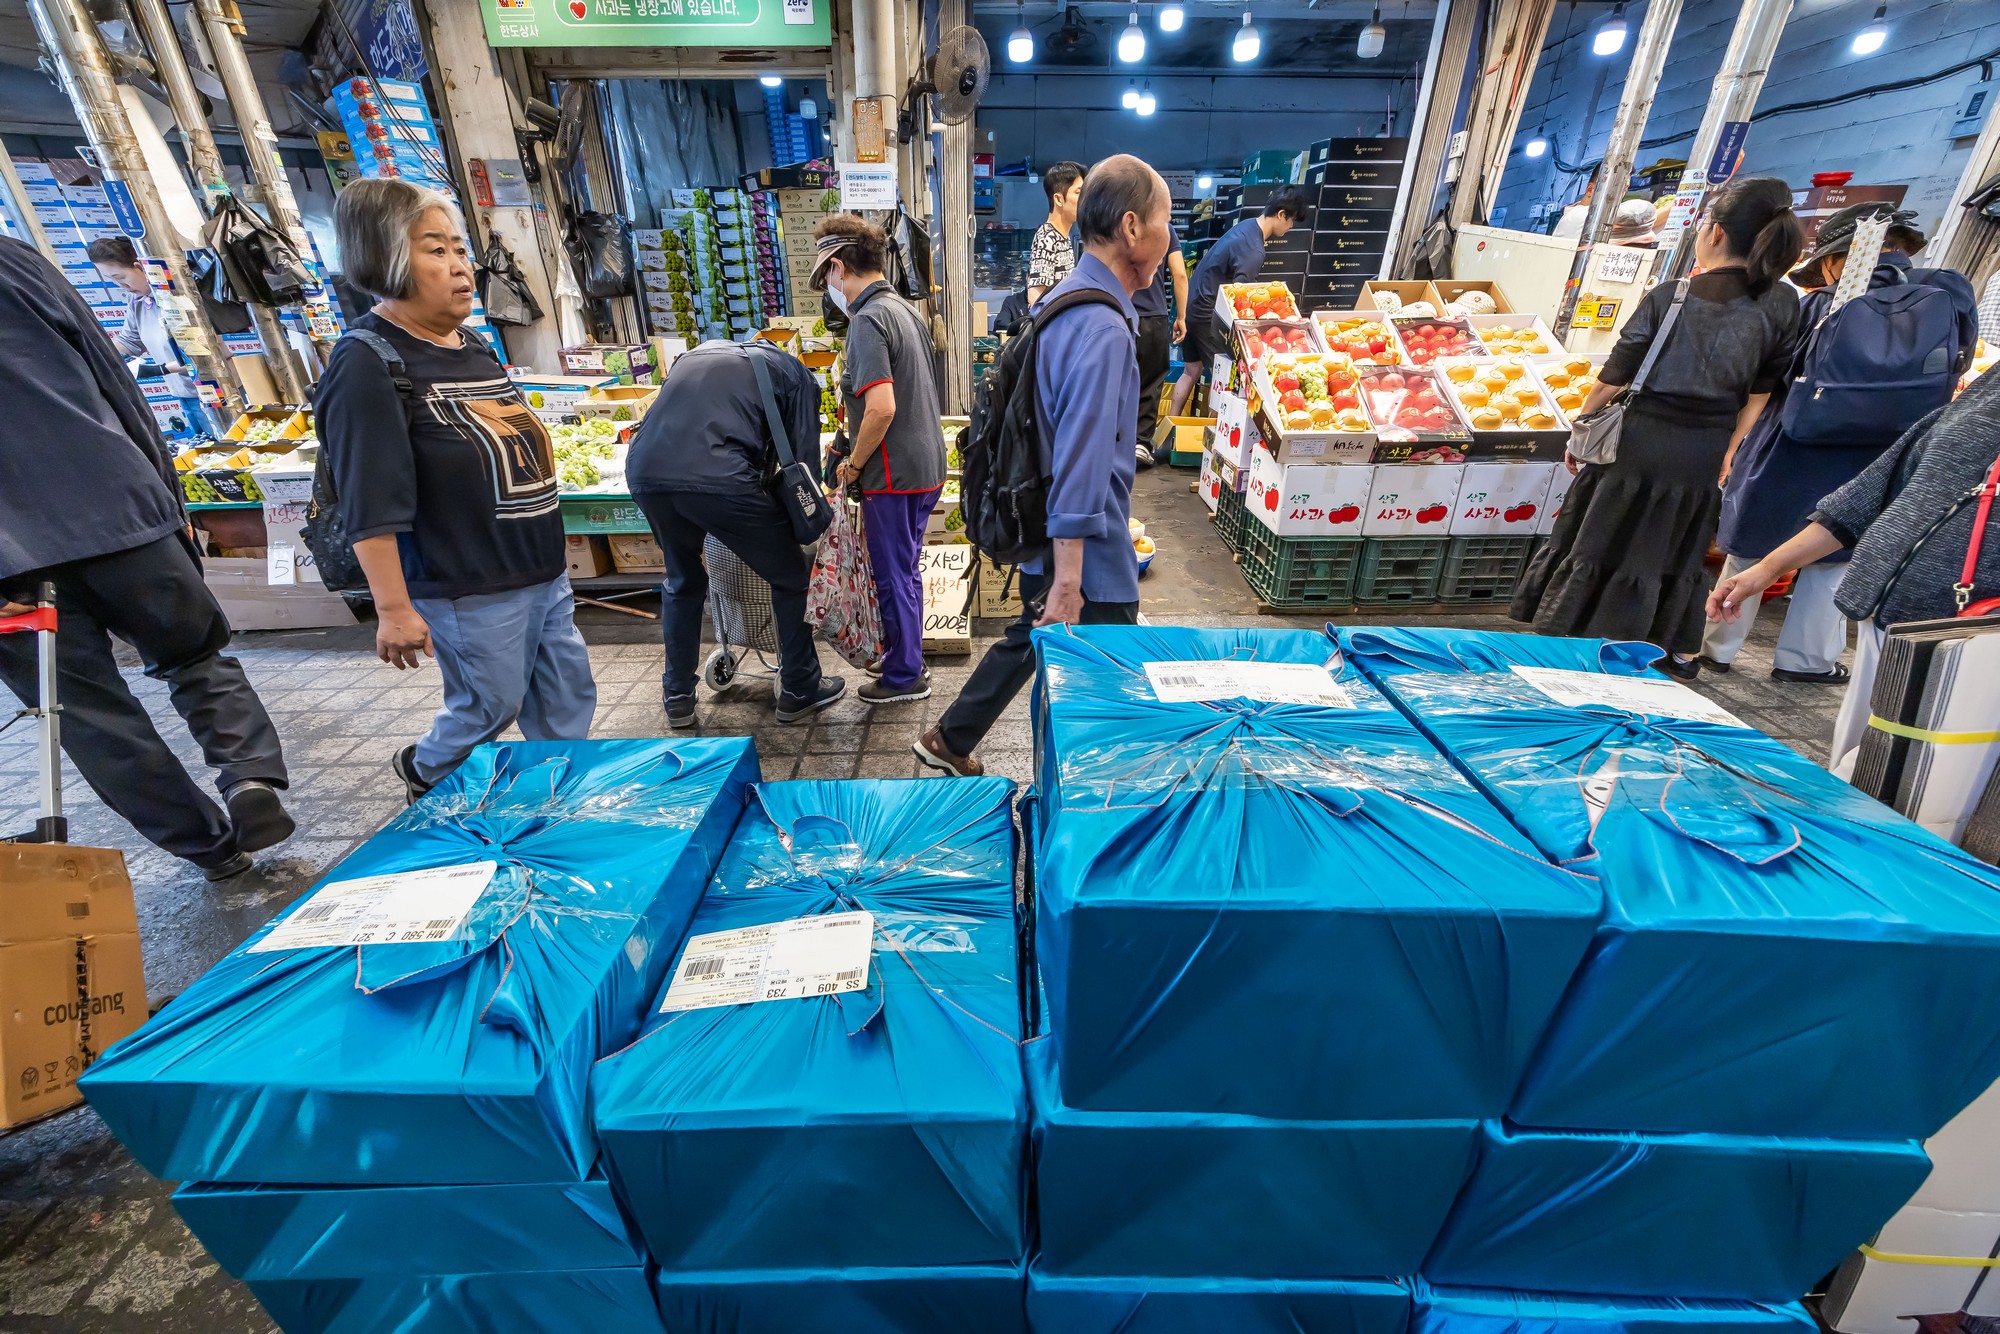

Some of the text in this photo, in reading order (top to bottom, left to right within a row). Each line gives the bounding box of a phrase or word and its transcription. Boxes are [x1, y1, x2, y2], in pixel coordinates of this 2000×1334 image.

[634, 0, 684, 16] 냉장고에
[687, 0, 741, 16] 있습니다.
[499, 24, 540, 38] 한도상사
[805, 172, 821, 183] 사과
[1217, 419, 1230, 438] 사과
[1389, 447, 1413, 457] 사과
[1201, 472, 1212, 487] 사과
[1250, 477, 1264, 497] 사과
[796, 485, 811, 506] NORTH
[796, 492, 807, 508] FACE
[805, 491, 815, 504] THE
[1289, 508, 1325, 520] 사과
[1377, 508, 1413, 520] 사과
[1464, 507, 1501, 519] 사과
[931, 551, 965, 571] 샤인
[274, 560, 290, 578] 5
[351, 929, 447, 942] MH 580 C 321
[716, 971, 726, 979] SS
[817, 982, 838, 993] 409
[845, 979, 860, 990] SS
[766, 987, 787, 999] 733
[44, 991, 125, 1026] couang
